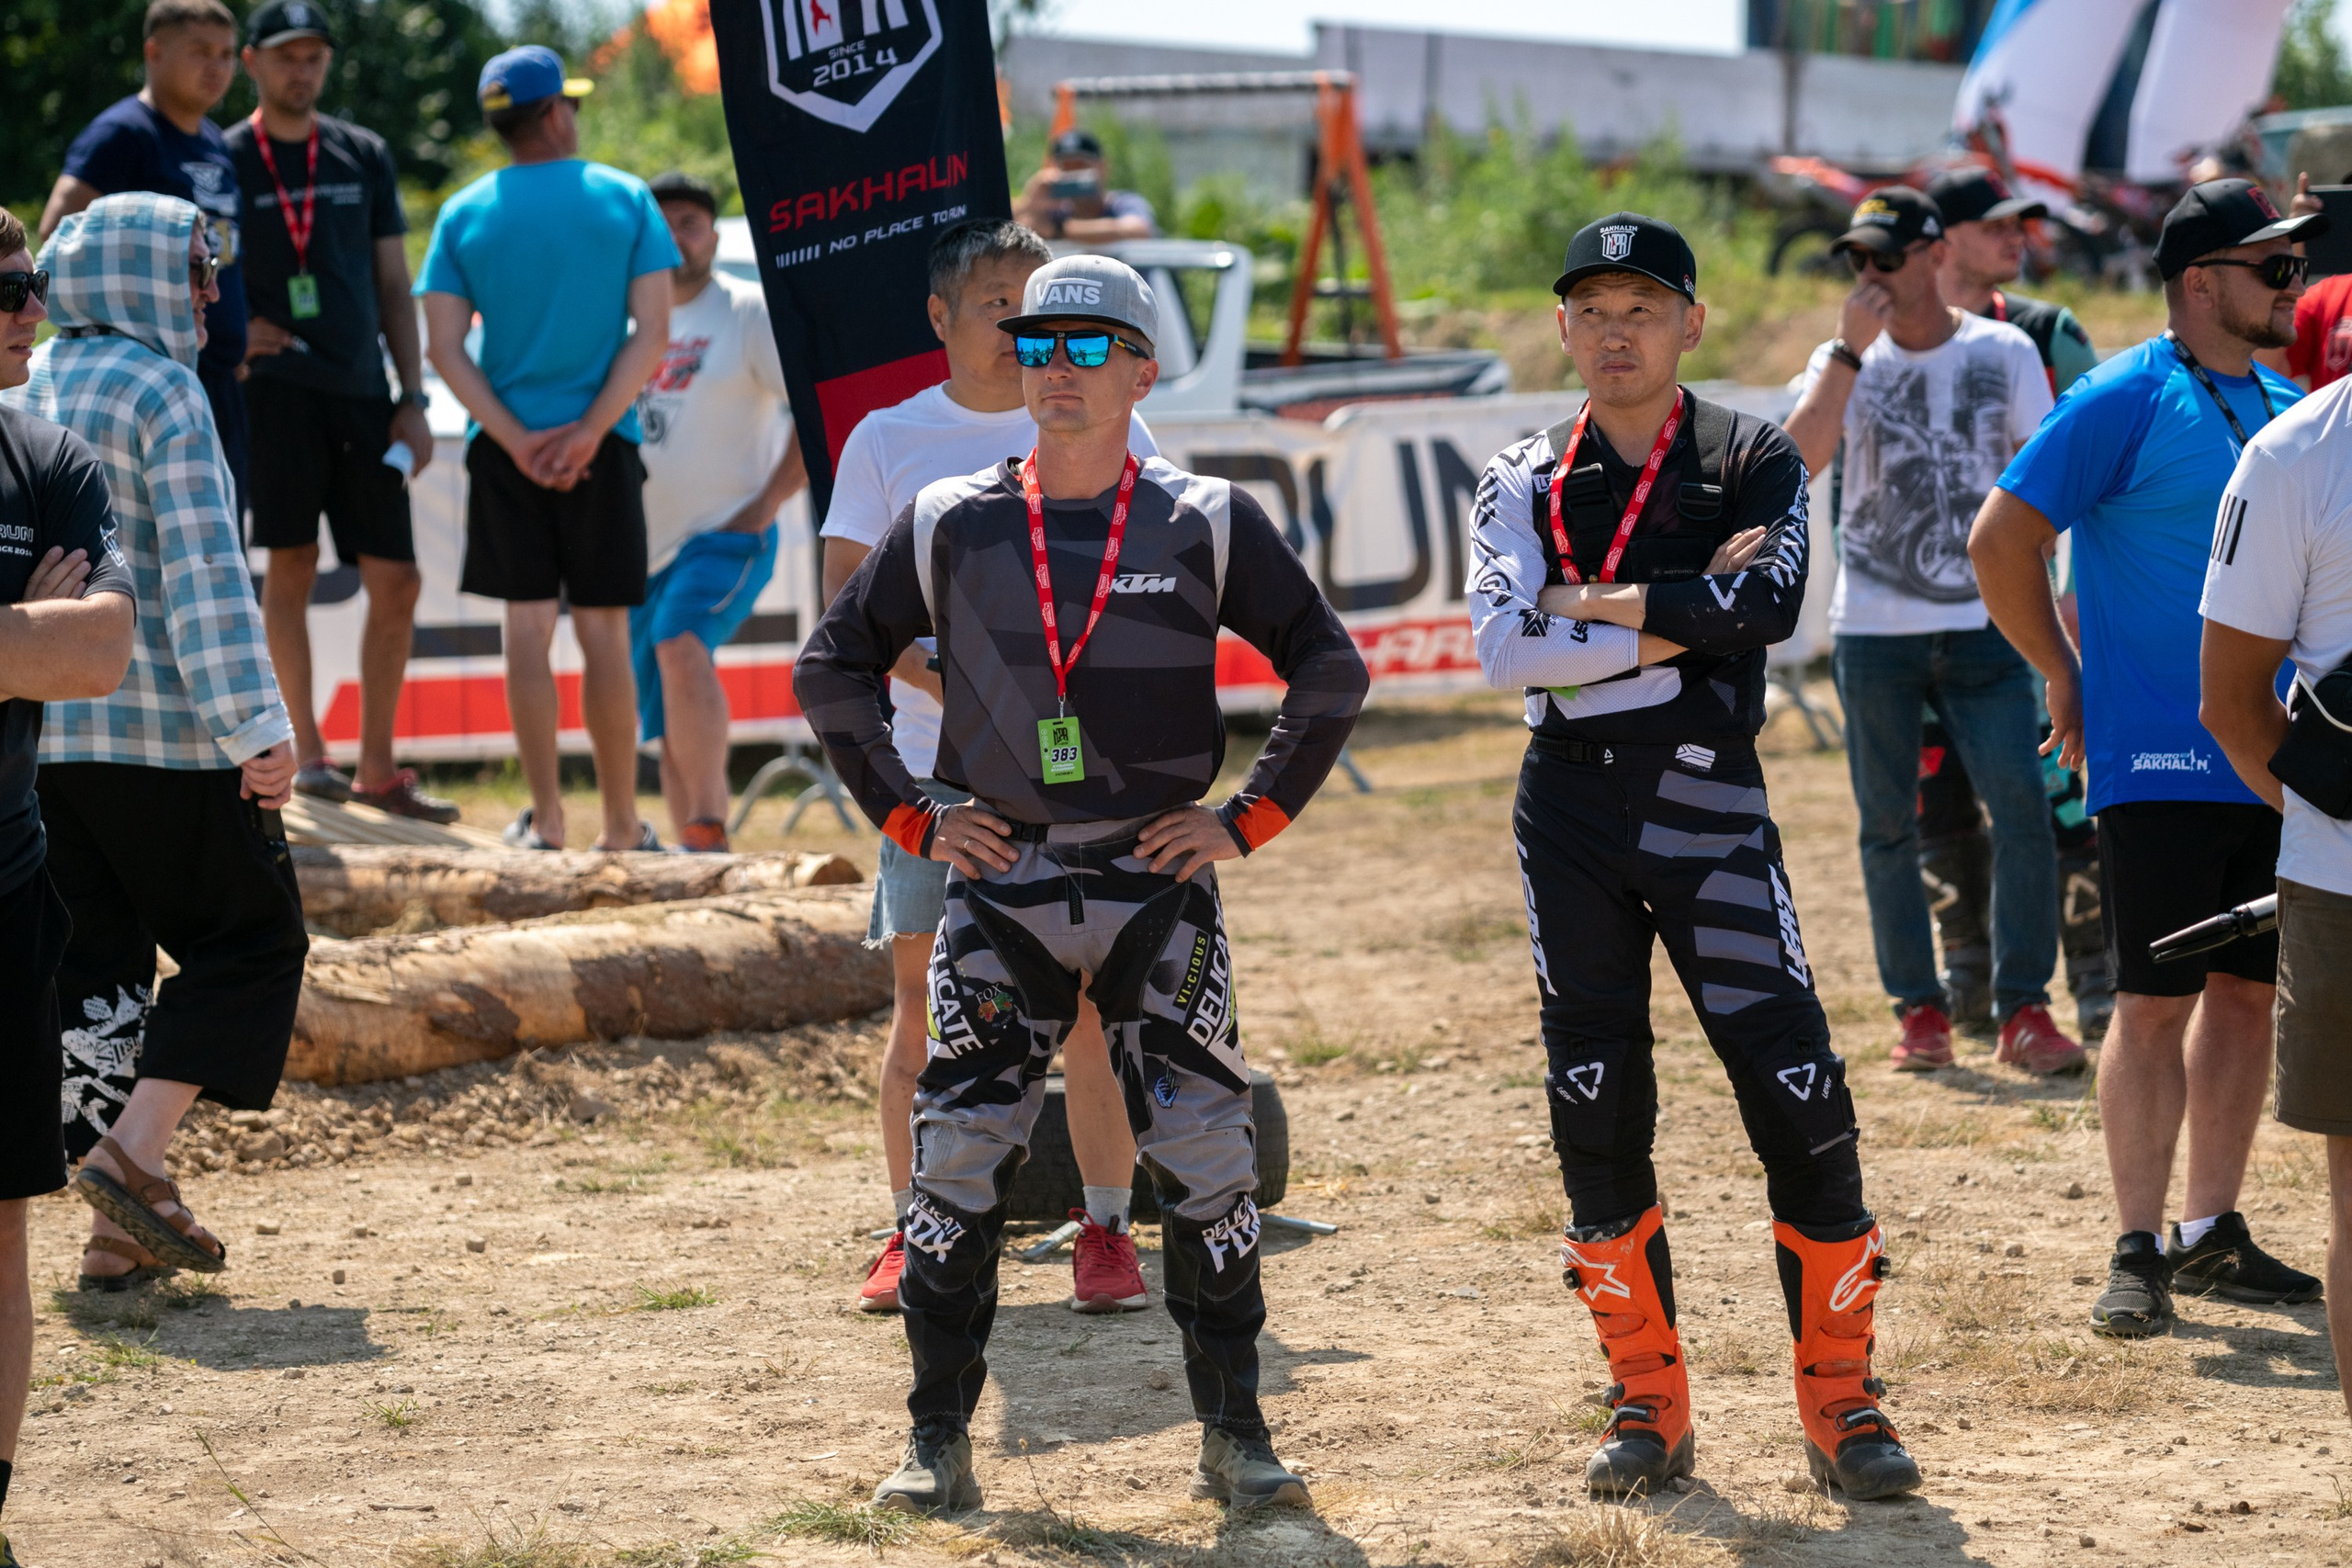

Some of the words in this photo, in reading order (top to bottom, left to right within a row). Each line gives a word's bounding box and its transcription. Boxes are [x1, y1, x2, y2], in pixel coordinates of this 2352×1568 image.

[828, 39, 866, 60] SINCE
[813, 47, 899, 87] 2014
[769, 152, 968, 233] SAKHALIN
[829, 234, 857, 254] NO
[864, 216, 925, 244] PLACE
[1600, 224, 1638, 233] SAKHALIN
[1036, 277, 1103, 308] VANS
[1110, 573, 1177, 593] KTM
[1051, 745, 1078, 763] 383
[976, 983, 1003, 1004] FOX
